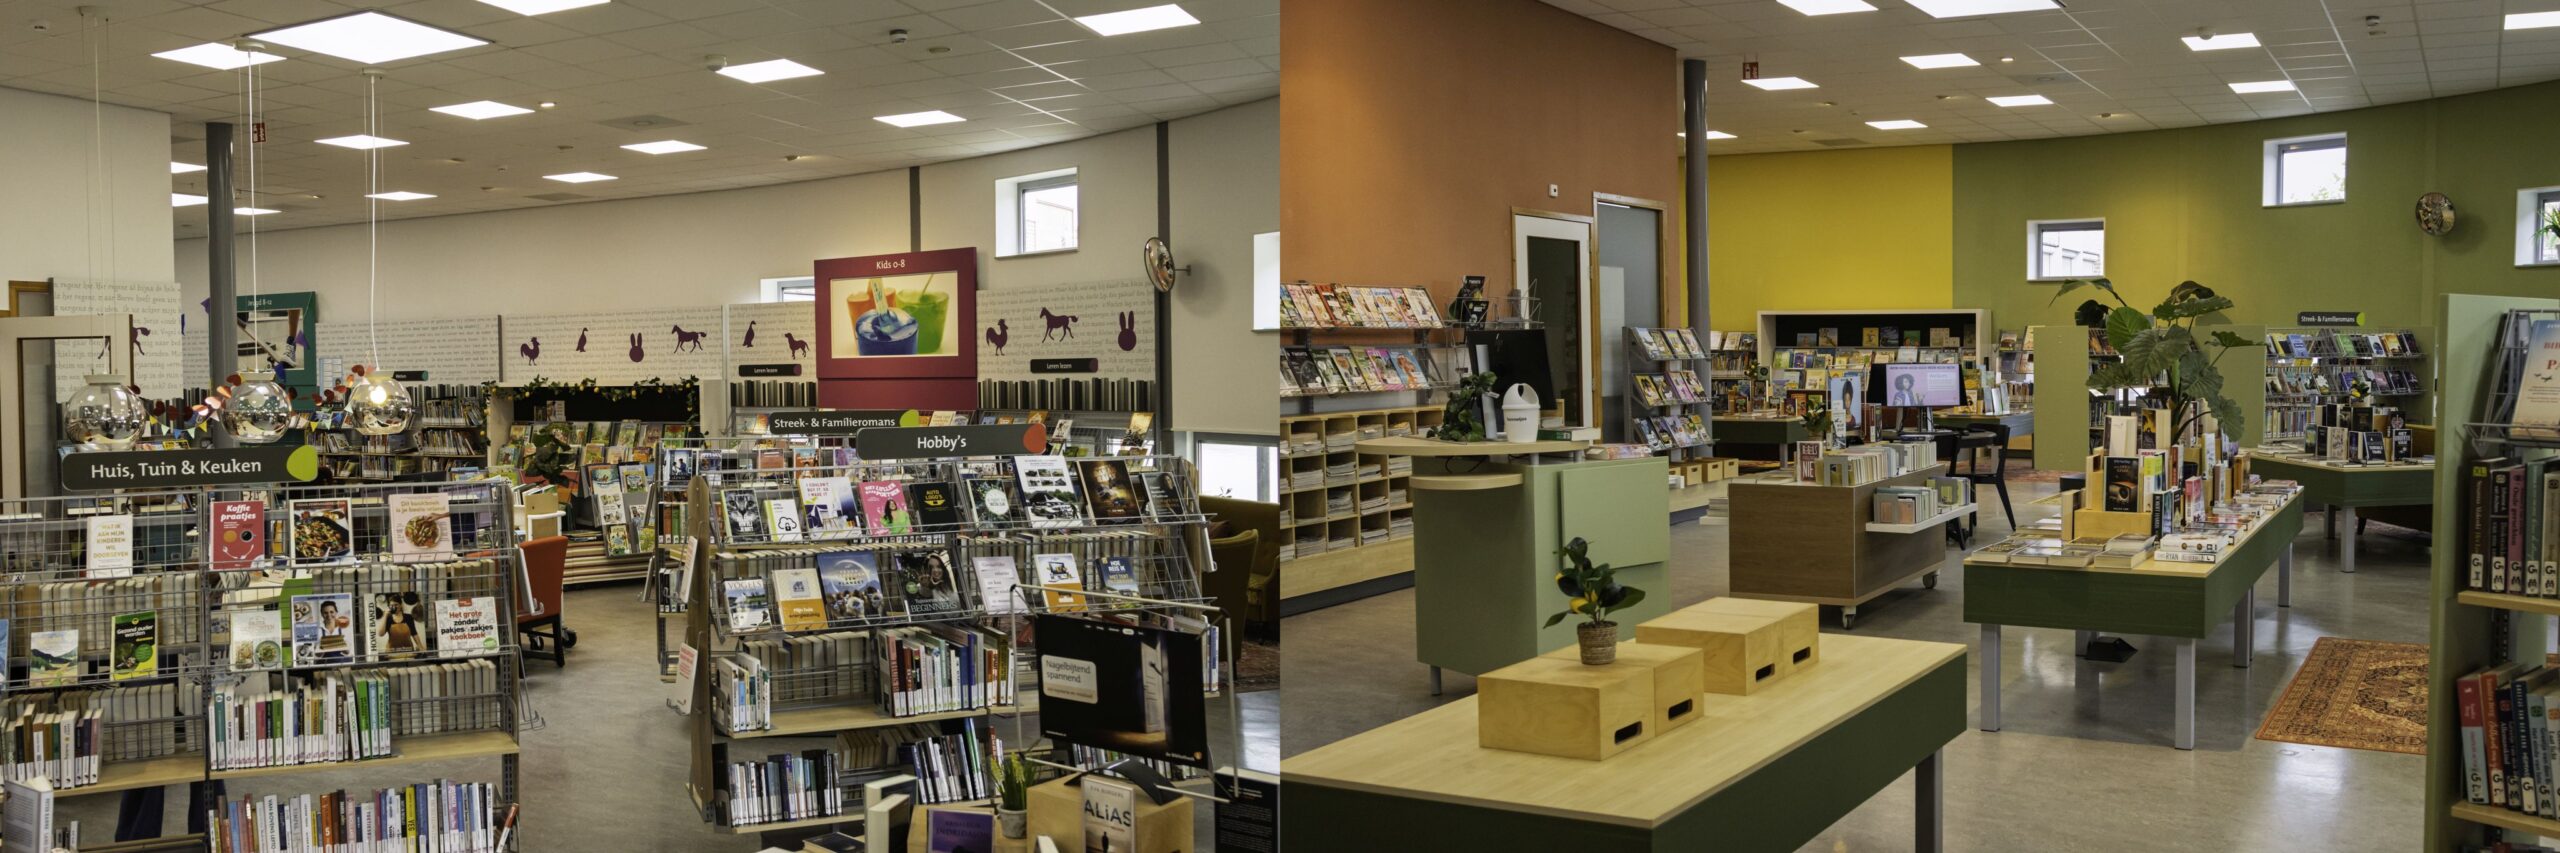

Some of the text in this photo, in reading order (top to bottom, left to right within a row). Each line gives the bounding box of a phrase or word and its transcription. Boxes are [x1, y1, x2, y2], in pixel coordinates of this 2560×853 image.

[876, 260, 892, 270] Kids
[774, 416, 896, 428] Streek- & Familieromans
[917, 435, 967, 451] Hobby's
[91, 458, 262, 480] Huis, Tuin & Keuken
[226, 504, 251, 513] Koffie
[220, 513, 256, 522] praatjes
[727, 580, 762, 590] VOGELS
[910, 602, 958, 613] BEGINNERS
[449, 610, 482, 619] Het grote
[453, 618, 479, 626] zonder
[441, 624, 493, 635] pakjes zakjes
[450, 632, 486, 640] kookboek
[1046, 660, 1091, 674] Nagelbijtend
[1046, 671, 1081, 684] spannend
